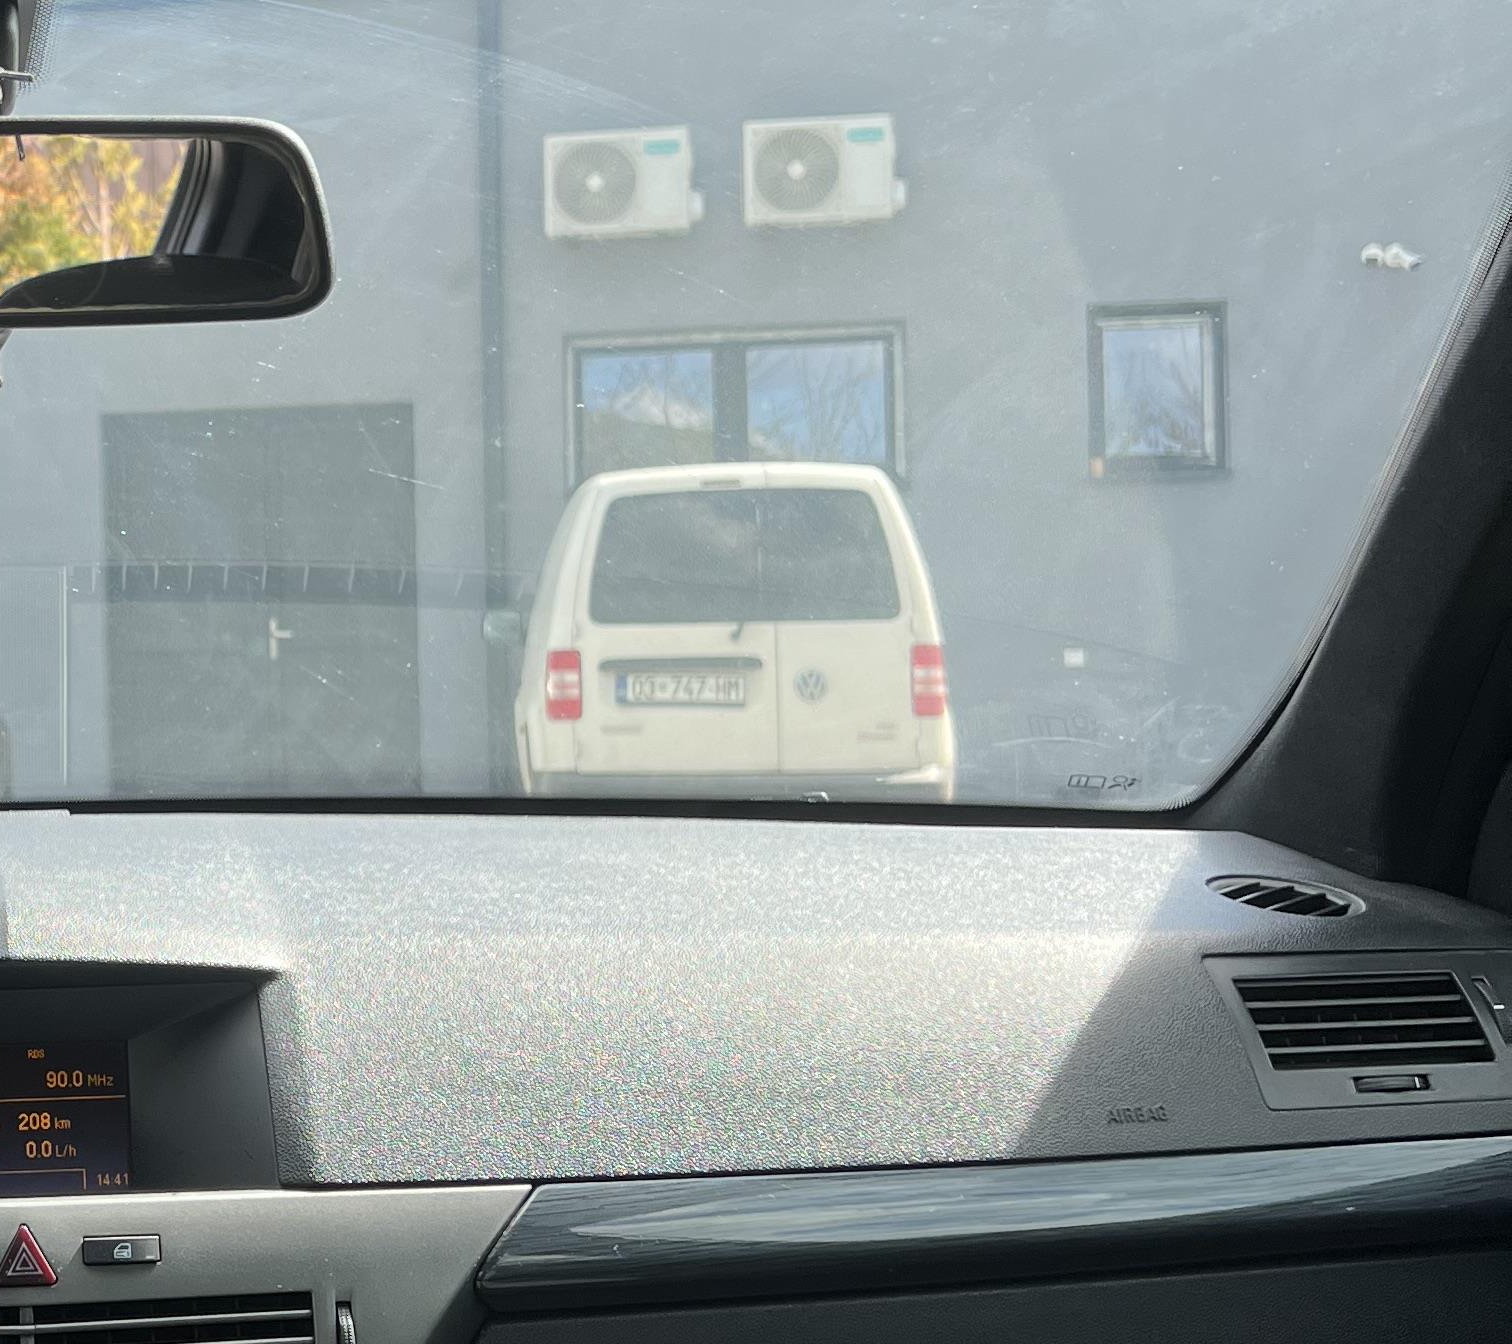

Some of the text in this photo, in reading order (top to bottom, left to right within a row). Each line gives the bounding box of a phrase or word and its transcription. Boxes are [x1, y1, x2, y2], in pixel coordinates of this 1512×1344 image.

[46, 1070, 83, 1088] 90.0
[87, 1073, 114, 1087] MHz
[17, 1112, 51, 1131] 208
[54, 1116, 71, 1129] km
[25, 1140, 52, 1158] 0.0
[55, 1144, 77, 1158] L/h
